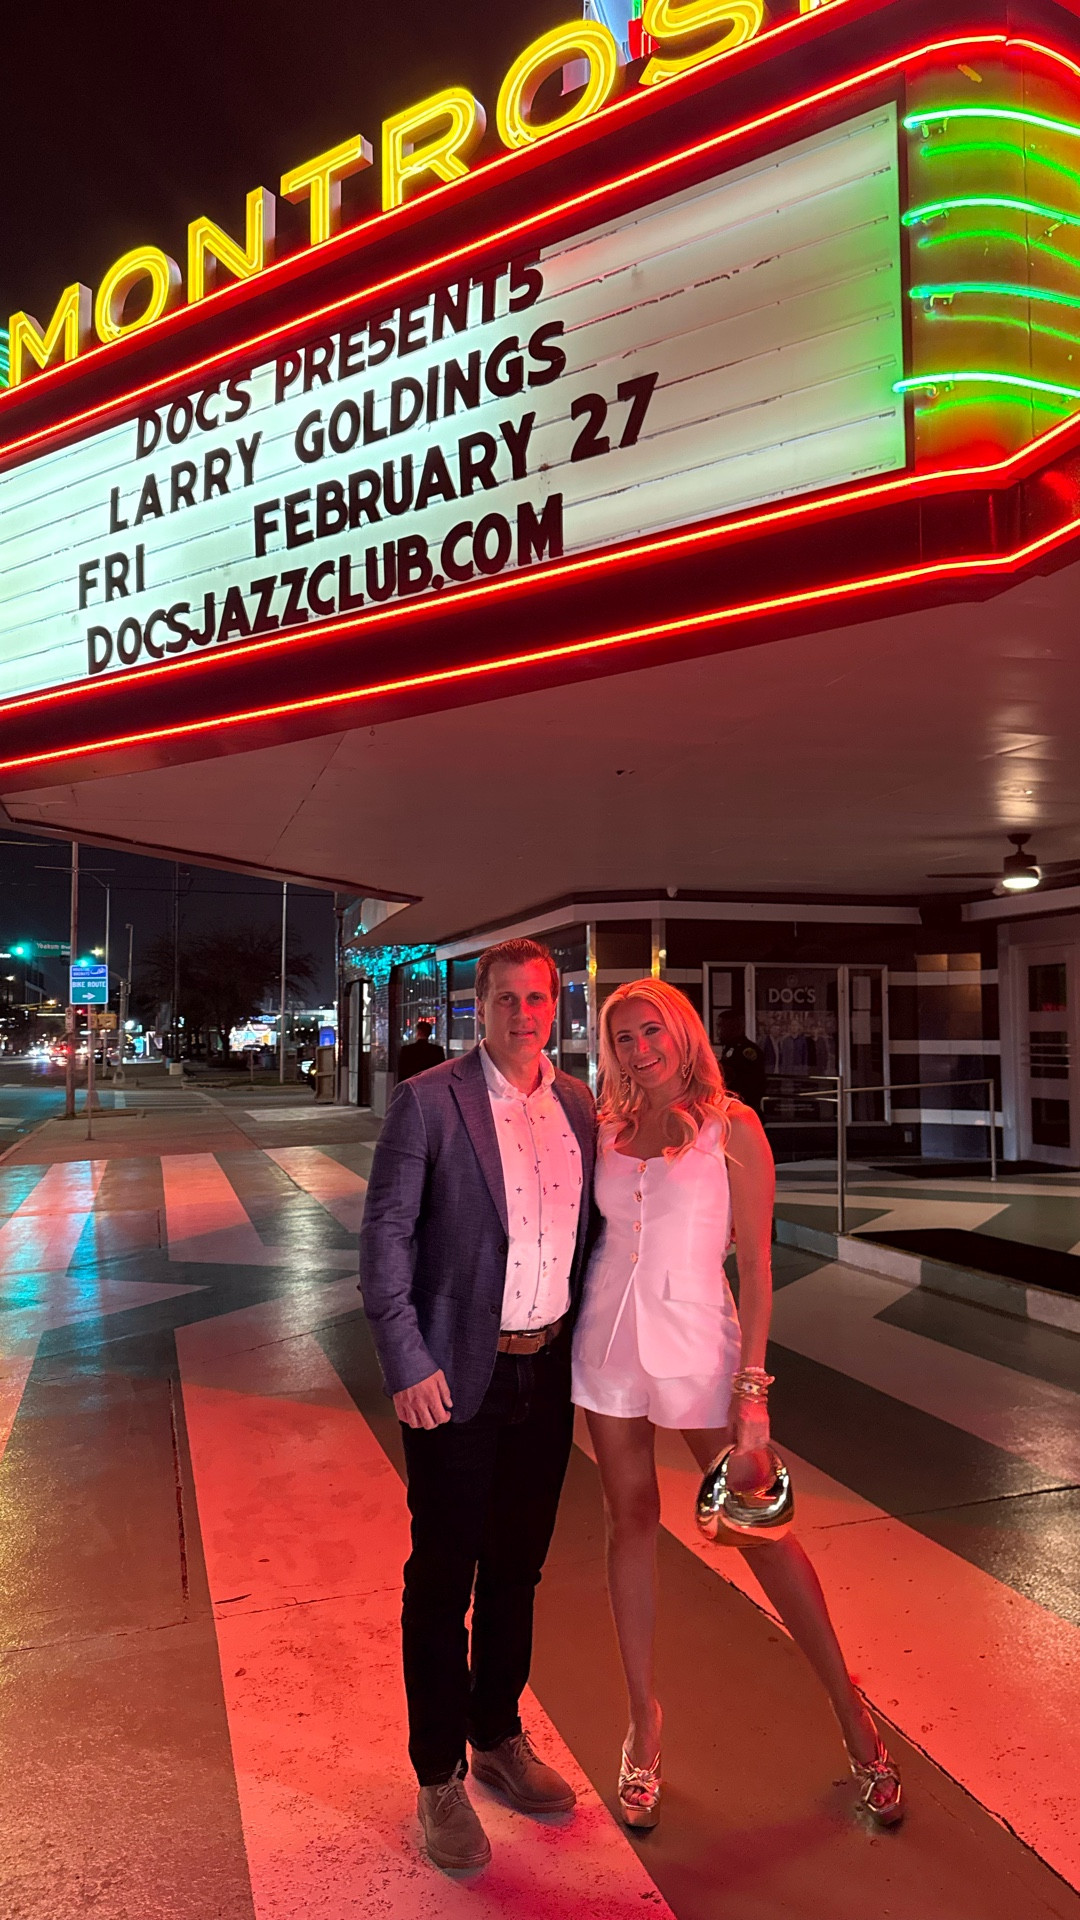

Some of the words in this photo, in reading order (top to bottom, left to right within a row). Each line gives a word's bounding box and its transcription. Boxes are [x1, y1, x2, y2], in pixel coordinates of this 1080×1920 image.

[7, 0, 848, 386] MONTROS
[78, 543, 146, 610] FRI
[253, 411, 536, 558] FEBRUARY
[569, 372, 659, 462] 27
[109, 430, 263, 535] LARRY
[295, 320, 567, 464] GOLDINGS
[136, 369, 252, 461] DOCS
[87, 493, 564, 675] DOCSJAZZCLUB.COM
[768, 986, 816, 1004] DOC'S
